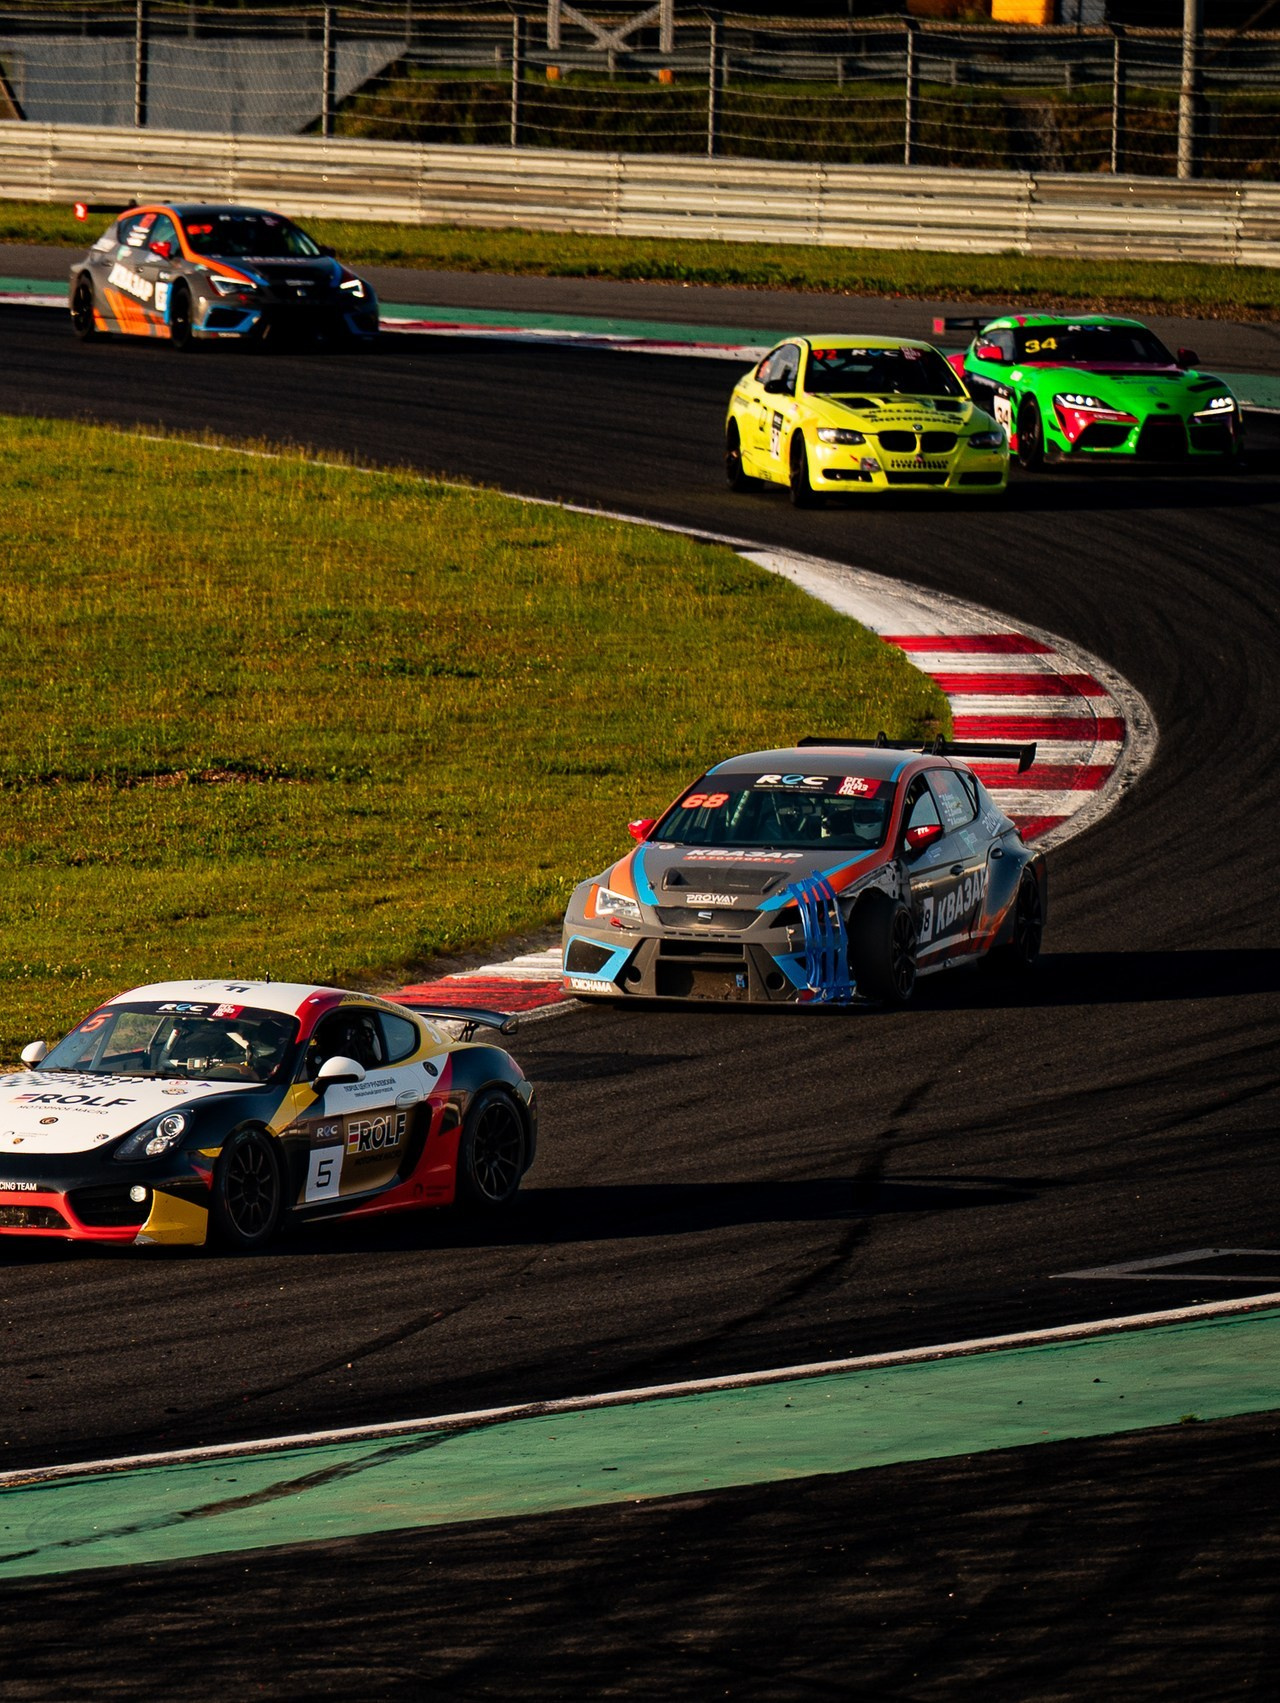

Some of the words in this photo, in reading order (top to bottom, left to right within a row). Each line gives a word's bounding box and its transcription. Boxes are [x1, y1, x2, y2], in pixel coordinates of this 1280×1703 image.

[1024, 337, 1058, 354] 34
[681, 793, 730, 809] 68
[686, 894, 739, 906] PROWAY
[570, 977, 613, 993] YOKOHAMA
[80, 1012, 113, 1033] 5
[27, 1093, 137, 1107] ROLF
[358, 1112, 407, 1151] ROLF
[316, 1159, 334, 1188] 5
[16, 1182, 37, 1192] TEAM
